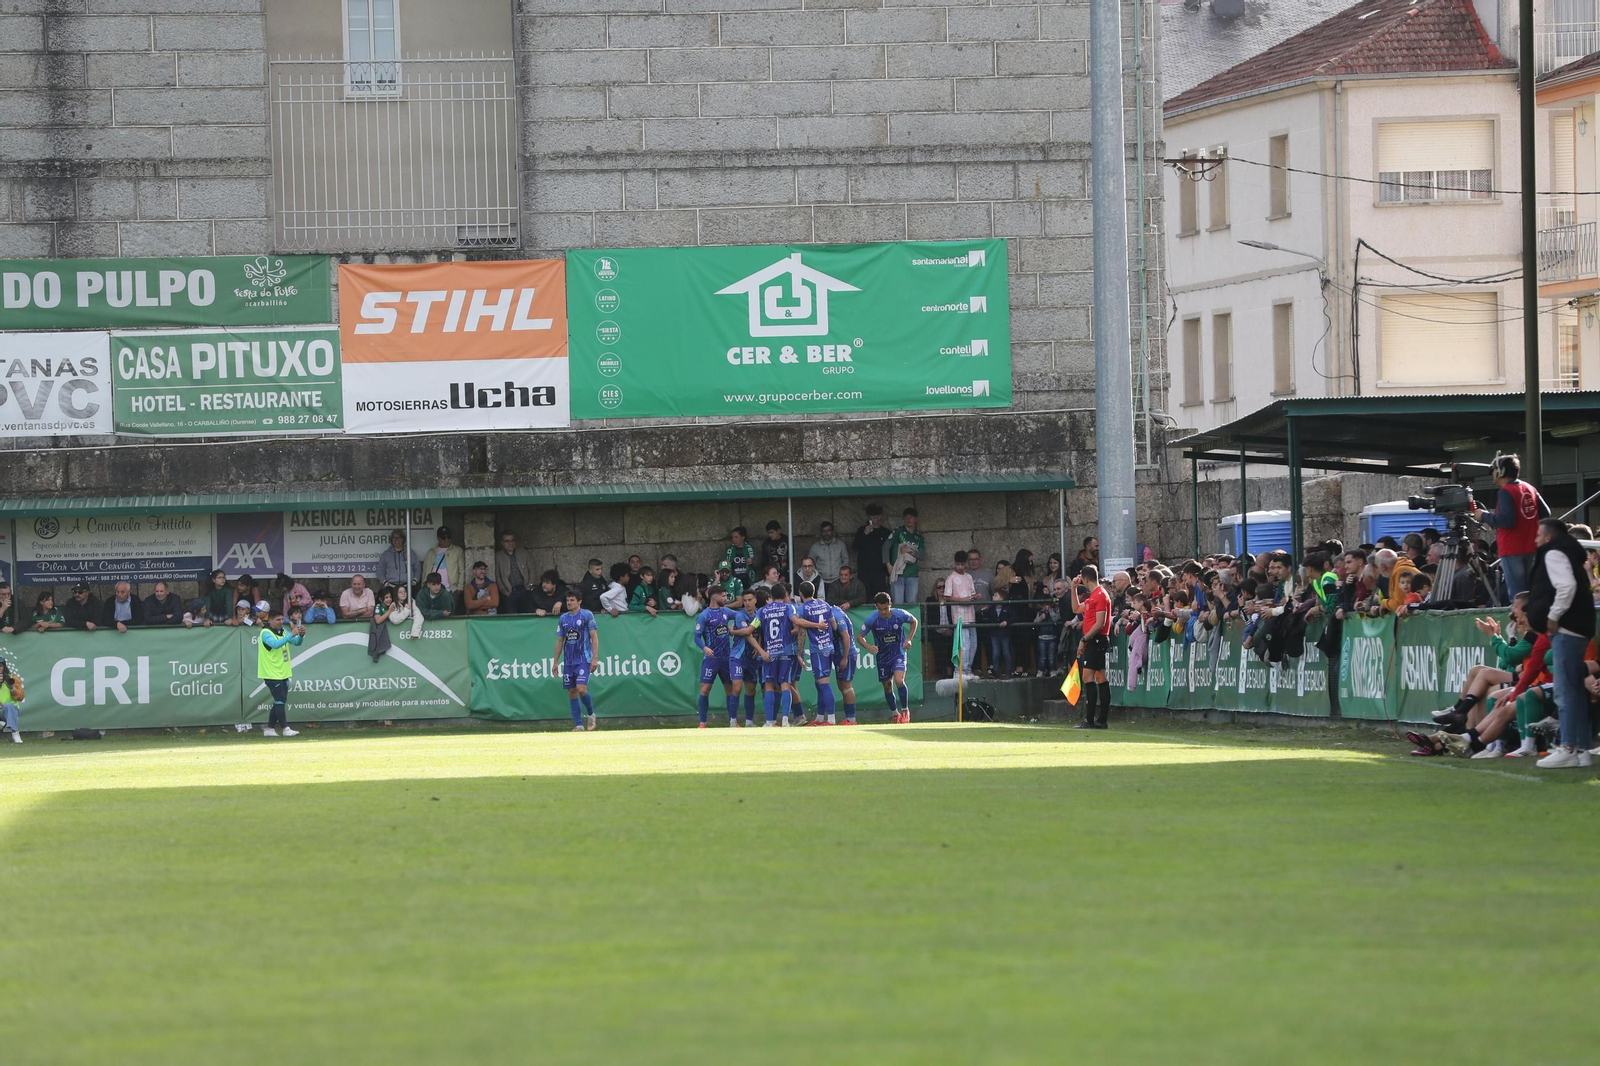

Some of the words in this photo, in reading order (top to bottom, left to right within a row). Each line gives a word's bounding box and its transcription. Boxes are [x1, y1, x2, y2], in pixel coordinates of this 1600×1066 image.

[3, 271, 61, 309] DO
[76, 269, 215, 308] PULPO
[353, 288, 554, 335] STIHL
[921, 302, 969, 312] centronorte
[118, 346, 183, 380] CASA
[191, 339, 335, 380] PITUXO
[727, 346, 772, 365] CER
[779, 345, 800, 364] &
[807, 344, 853, 363] BER
[822, 366, 855, 375] GRUPO
[131, 395, 186, 412] HOTEL
[200, 390, 323, 411] RESTAURANTE
[356, 399, 448, 411] MOTOSIERRAS
[449, 381, 556, 409] Ucha
[602, 390, 619, 399] CIES
[723, 389, 863, 404] www.grupocerber.com
[194, 418, 230, 427] CARBALLIÑO
[278, 415, 296, 424] 988
[298, 415, 309, 424] 27
[312, 415, 324, 423] 08
[327, 414, 338, 423] 47
[290, 509, 357, 527] AXENCIA
[319, 533, 355, 547] JULIÁN
[358, 534, 392, 545] GARRI
[166, 549, 193, 558] postres
[217, 542, 274, 571] AXA
[37, 560, 68, 572] Pilar
[322, 564, 336, 572] 988
[337, 564, 346, 572] 27
[347, 564, 356, 572] 12
[358, 564, 366, 572] 12
[769, 618, 780, 640] 6
[168, 660, 228, 676] Towers
[592, 653, 652, 677] alicia
[705, 668, 713, 677] 15
[735, 665, 743, 674] 10
[50, 656, 150, 707] GRI
[170, 680, 223, 696] Galicia
[287, 703, 293, 711] y
[317, 701, 327, 709] de
[328, 700, 355, 710] carpas
[355, 701, 361, 709] y
[362, 699, 400, 708] mobiliario
[401, 699, 420, 708] para
[420, 697, 450, 706] eventos
